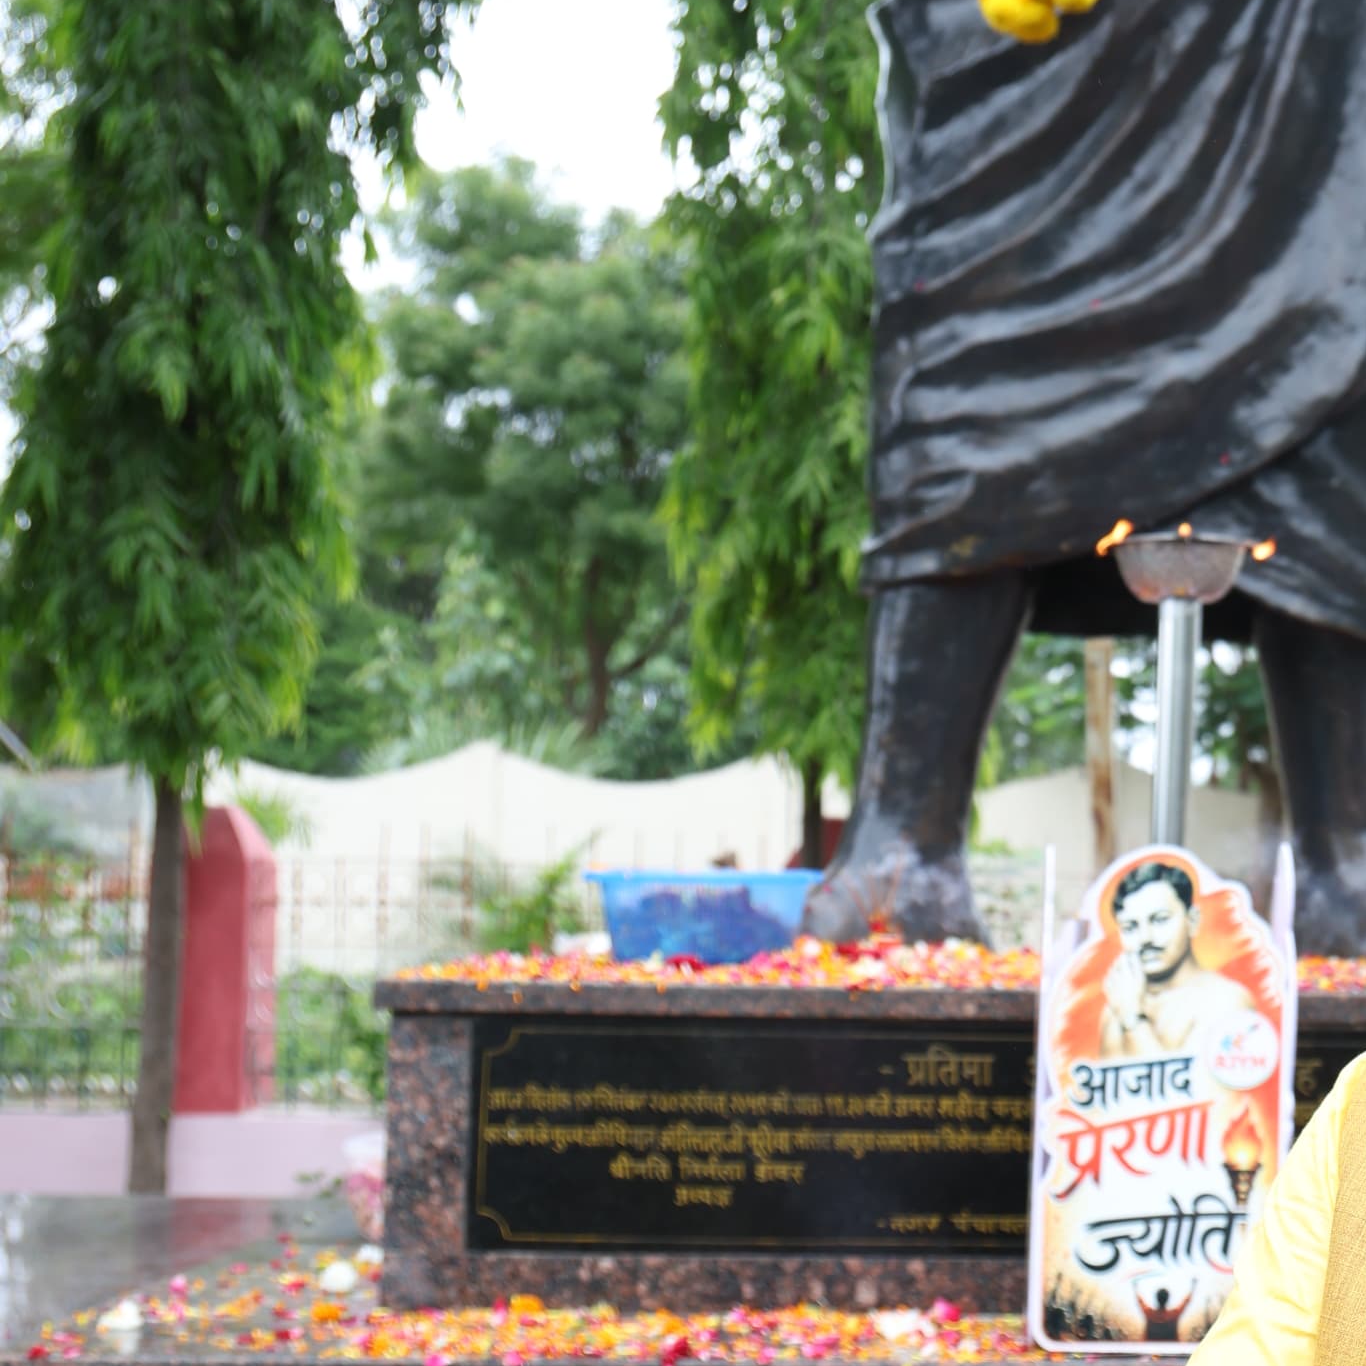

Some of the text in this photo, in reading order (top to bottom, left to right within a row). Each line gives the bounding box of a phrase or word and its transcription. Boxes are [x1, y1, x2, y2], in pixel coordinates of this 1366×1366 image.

[902, 1044, 995, 1086] प्रतिमा
[1069, 1056, 1195, 1108] आजाद
[1055, 1101, 1214, 1202] प्रेरणा
[1074, 1193, 1247, 1272] ज्योति
